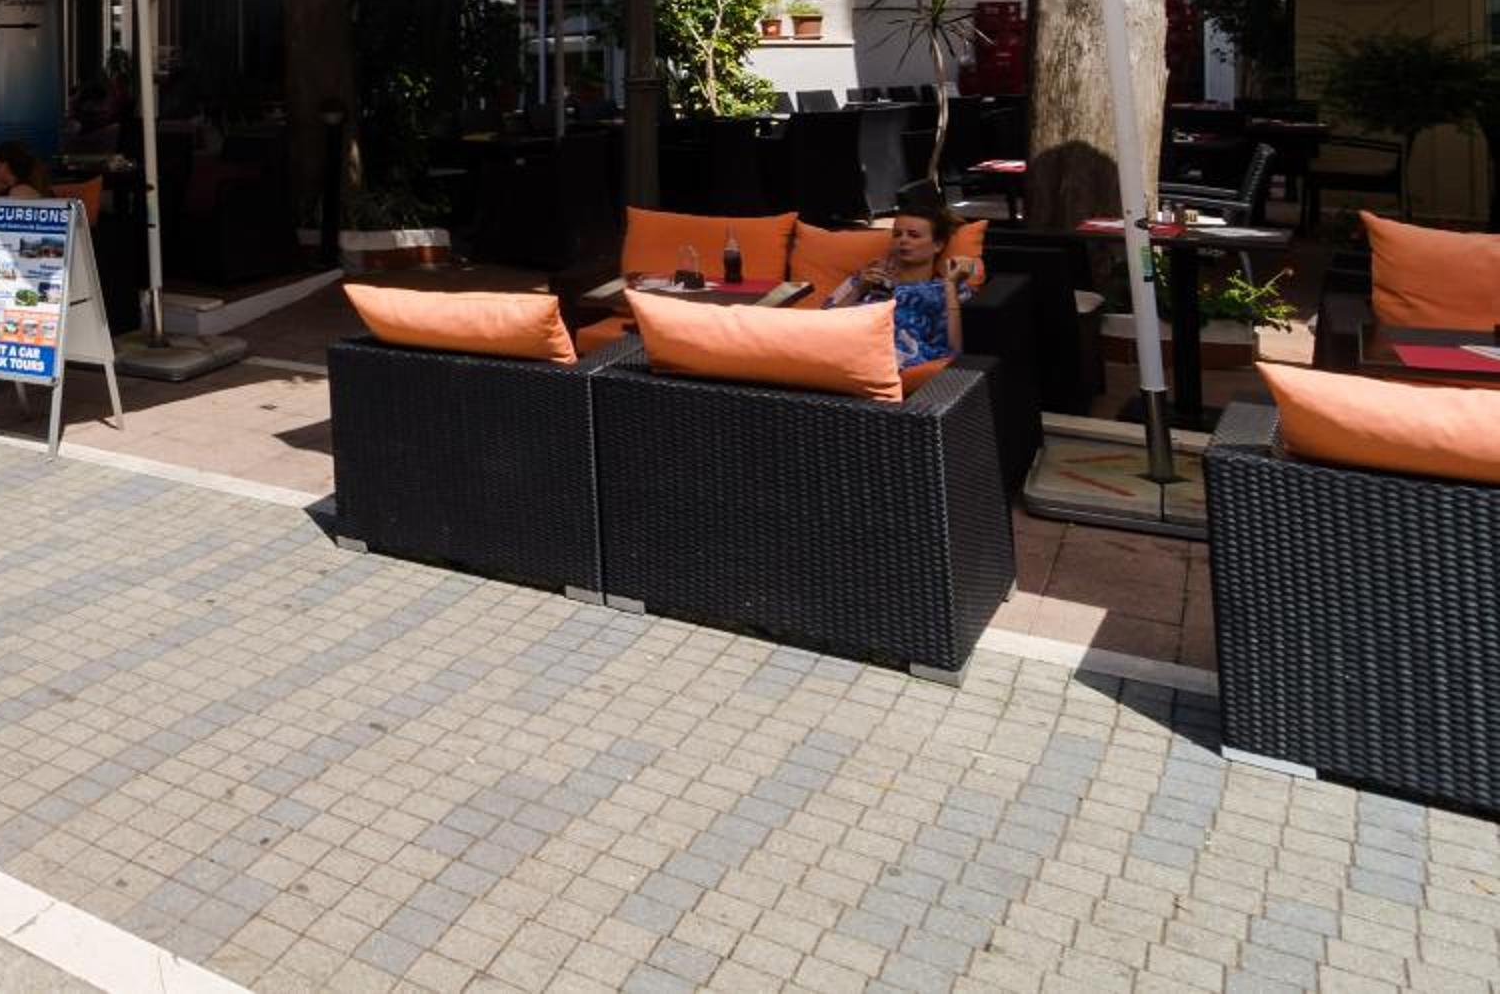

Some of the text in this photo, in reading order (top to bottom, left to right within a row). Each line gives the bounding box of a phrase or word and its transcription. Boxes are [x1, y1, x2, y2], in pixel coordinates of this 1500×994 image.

[8, 345, 17, 357] A
[18, 347, 41, 359] CAR
[9, 357, 45, 372] TOURS
